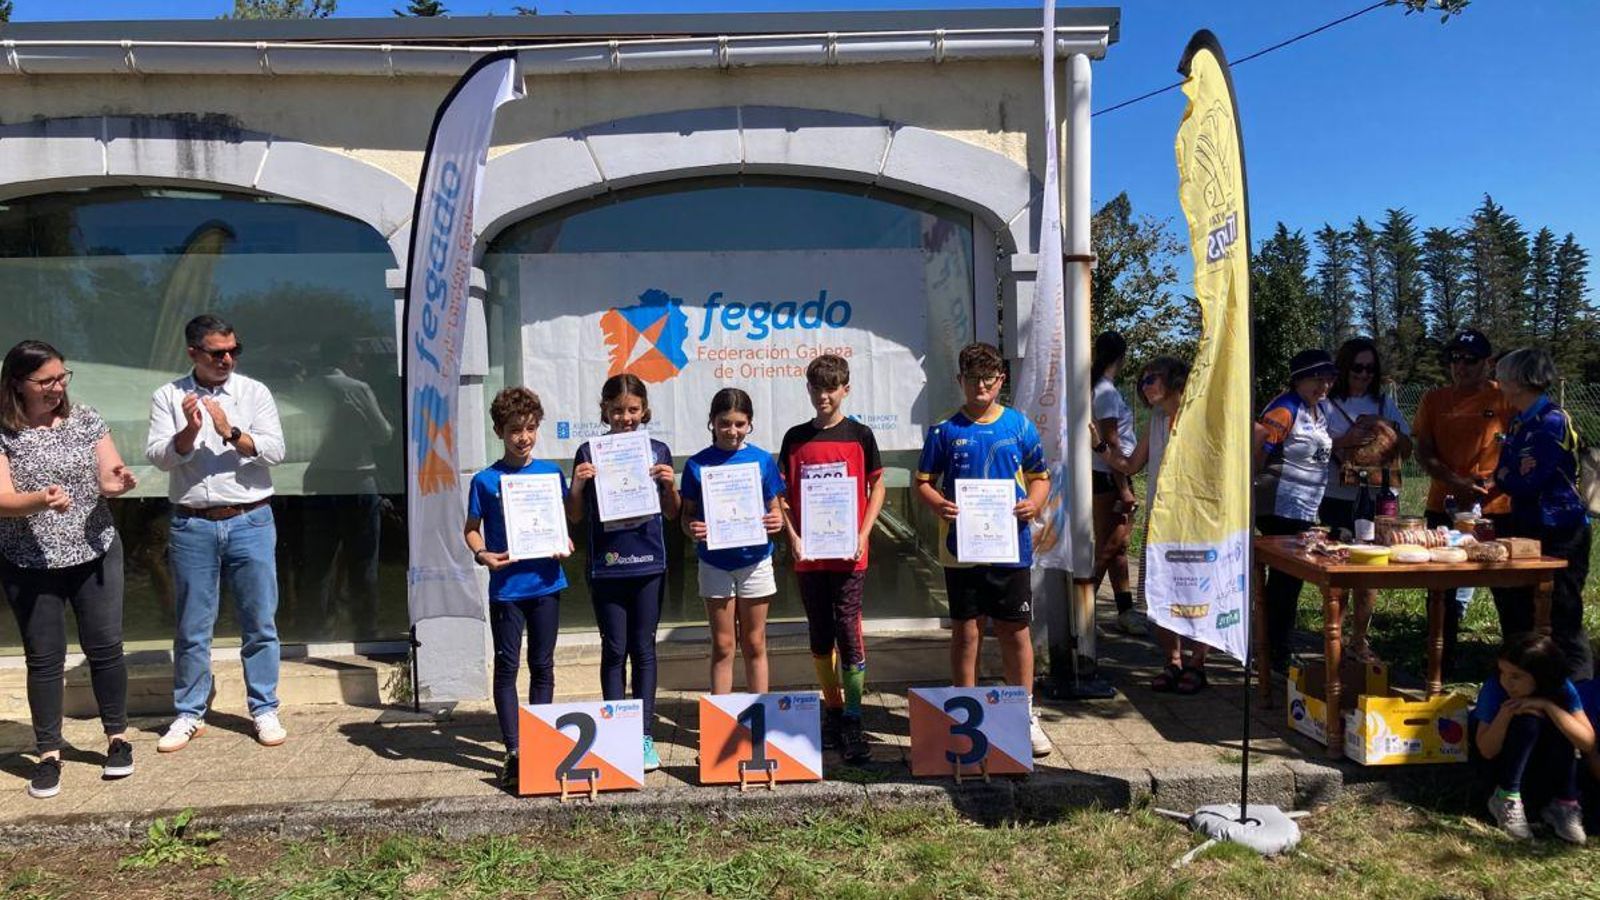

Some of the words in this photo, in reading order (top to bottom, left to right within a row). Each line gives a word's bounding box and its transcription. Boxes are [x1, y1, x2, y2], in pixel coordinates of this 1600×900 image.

[415, 161, 461, 373] fegado
[699, 290, 852, 341] fegado
[697, 344, 790, 361] Federación
[714, 364, 734, 378] de
[983, 522, 990, 531] 3
[555, 712, 600, 781] 2
[737, 703, 778, 771] 1
[944, 696, 988, 765] 3
